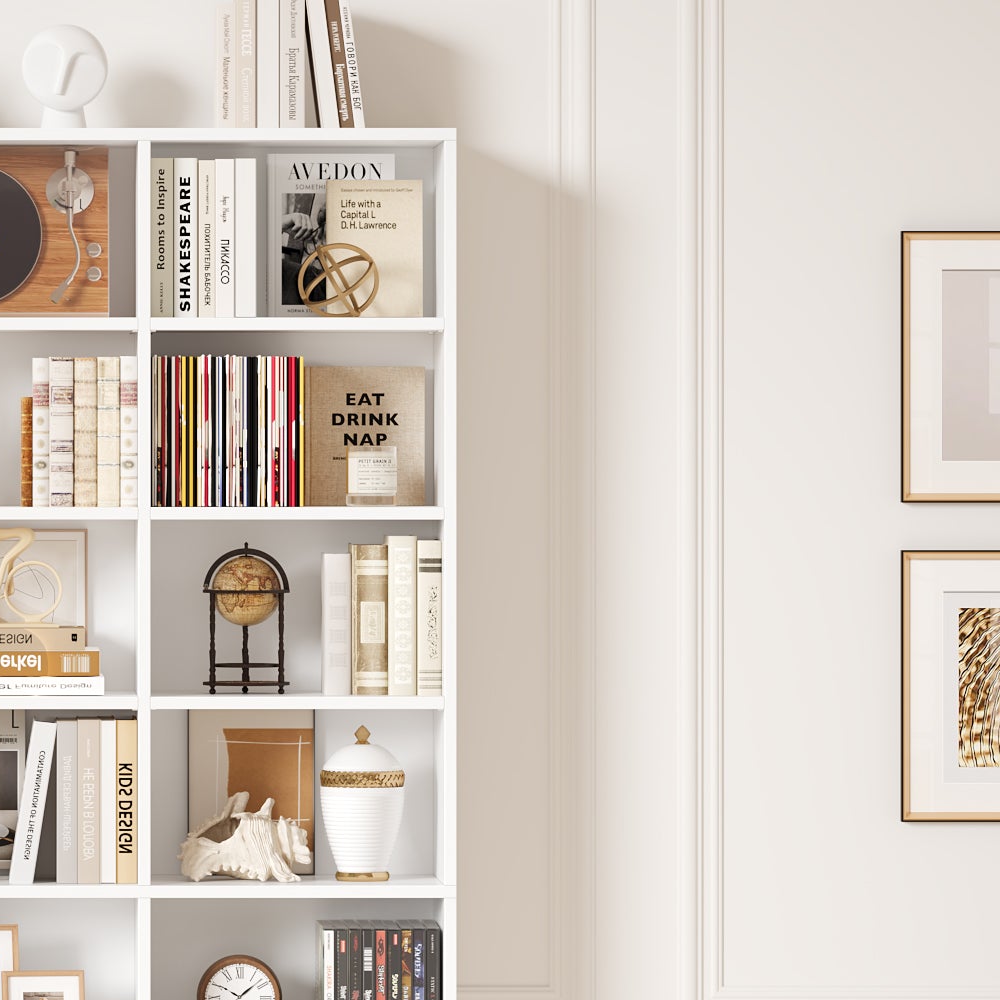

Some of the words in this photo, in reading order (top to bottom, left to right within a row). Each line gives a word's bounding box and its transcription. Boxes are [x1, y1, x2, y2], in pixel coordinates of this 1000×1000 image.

[285, 48, 299, 74] Братья
[345, 42, 357, 77] ГОВОРИ
[353, 97, 362, 110] БОГ
[285, 75, 299, 121] Карамазовы
[288, 162, 383, 180] AVEDON
[156, 168, 167, 210] Inspire
[340, 199, 356, 208] Life
[357, 199, 375, 208] with
[156, 213, 165, 226] to
[340, 210, 369, 219] Capital
[371, 210, 376, 218] L
[340, 221, 348, 229] D.
[349, 221, 358, 229] H.
[359, 221, 397, 229] Lawrence
[156, 230, 165, 270] Rooms
[179, 176, 191, 312] SHAKESPEARE
[220, 239, 230, 285] ПИКАССО
[345, 392, 385, 406] EAT
[331, 413, 399, 426] DRINK
[343, 433, 388, 446] NAP
